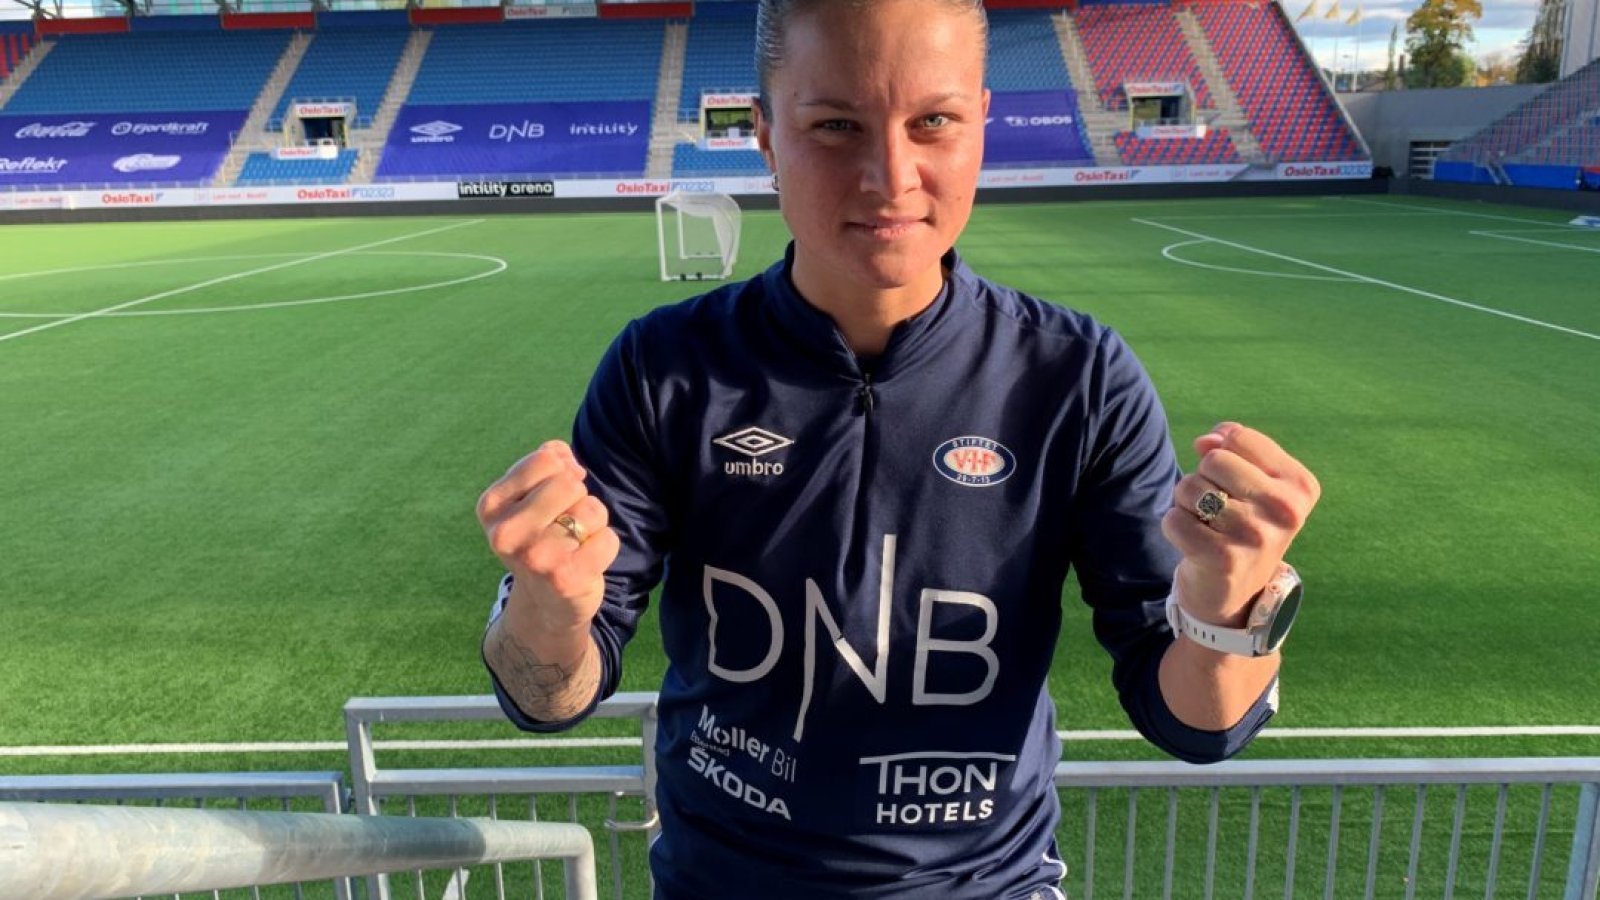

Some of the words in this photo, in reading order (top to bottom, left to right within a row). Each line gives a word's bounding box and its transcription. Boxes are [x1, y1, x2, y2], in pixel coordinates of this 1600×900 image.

[1030, 116, 1072, 126] OBOS
[132, 122, 209, 135] Fjordkraft
[489, 120, 545, 142] DNB
[1074, 171, 1128, 182] OsloTaxi
[1284, 166, 1341, 177] OsloTaxi
[297, 188, 350, 200] OsloTaxi
[510, 182, 553, 195] arena
[616, 182, 669, 193] OsloTaxi
[102, 193, 154, 204] OsloTaxi
[725, 458, 784, 476] umbro
[703, 534, 1000, 742] DNB
[771, 748, 797, 783] Bil
[859, 751, 1016, 796] THON
[876, 798, 995, 824] HOTELS
